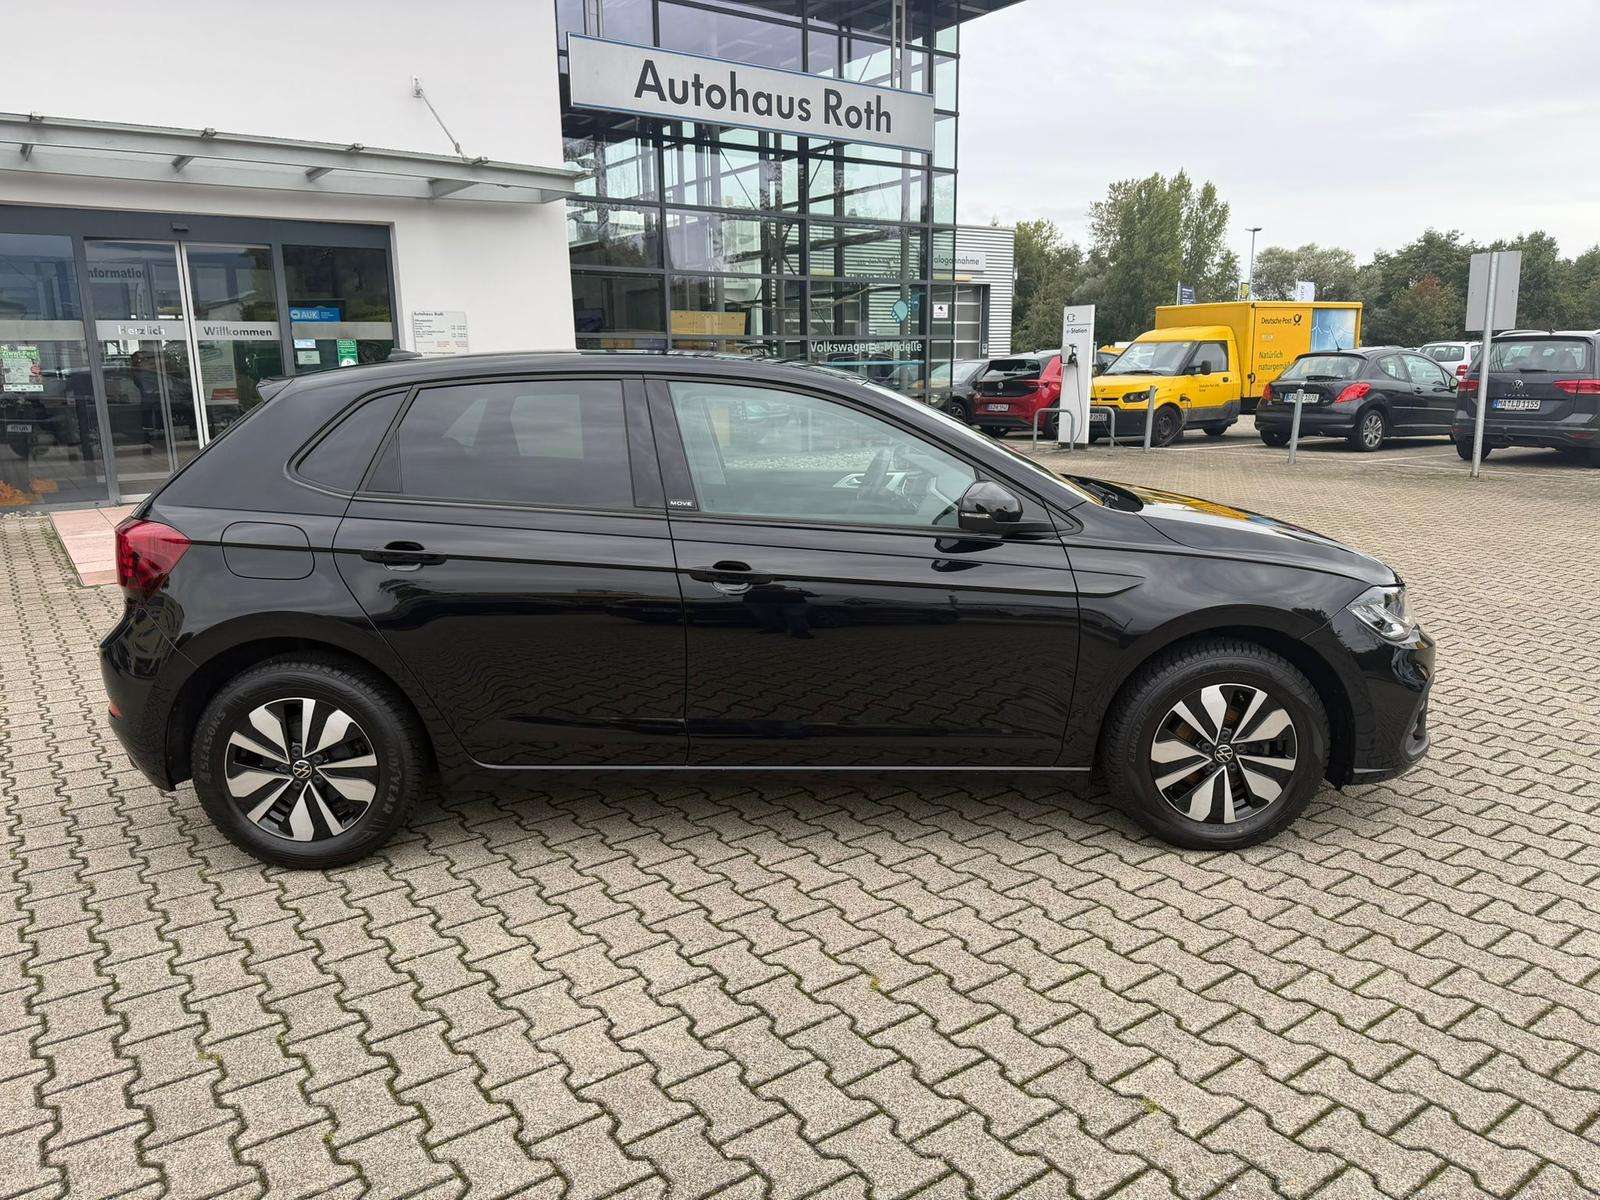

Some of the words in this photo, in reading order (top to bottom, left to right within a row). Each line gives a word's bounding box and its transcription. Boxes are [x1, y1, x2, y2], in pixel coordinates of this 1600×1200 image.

[634, 59, 811, 122] Autohaus
[823, 88, 891, 133] Roth
[933, 254, 979, 266] aloganahme
[88, 267, 144, 278] nformatio
[118, 325, 164, 336] Herzlich
[203, 326, 272, 337] Willkommen
[809, 341, 871, 354] Volkswagen
[1259, 350, 1284, 359] Natürlich
